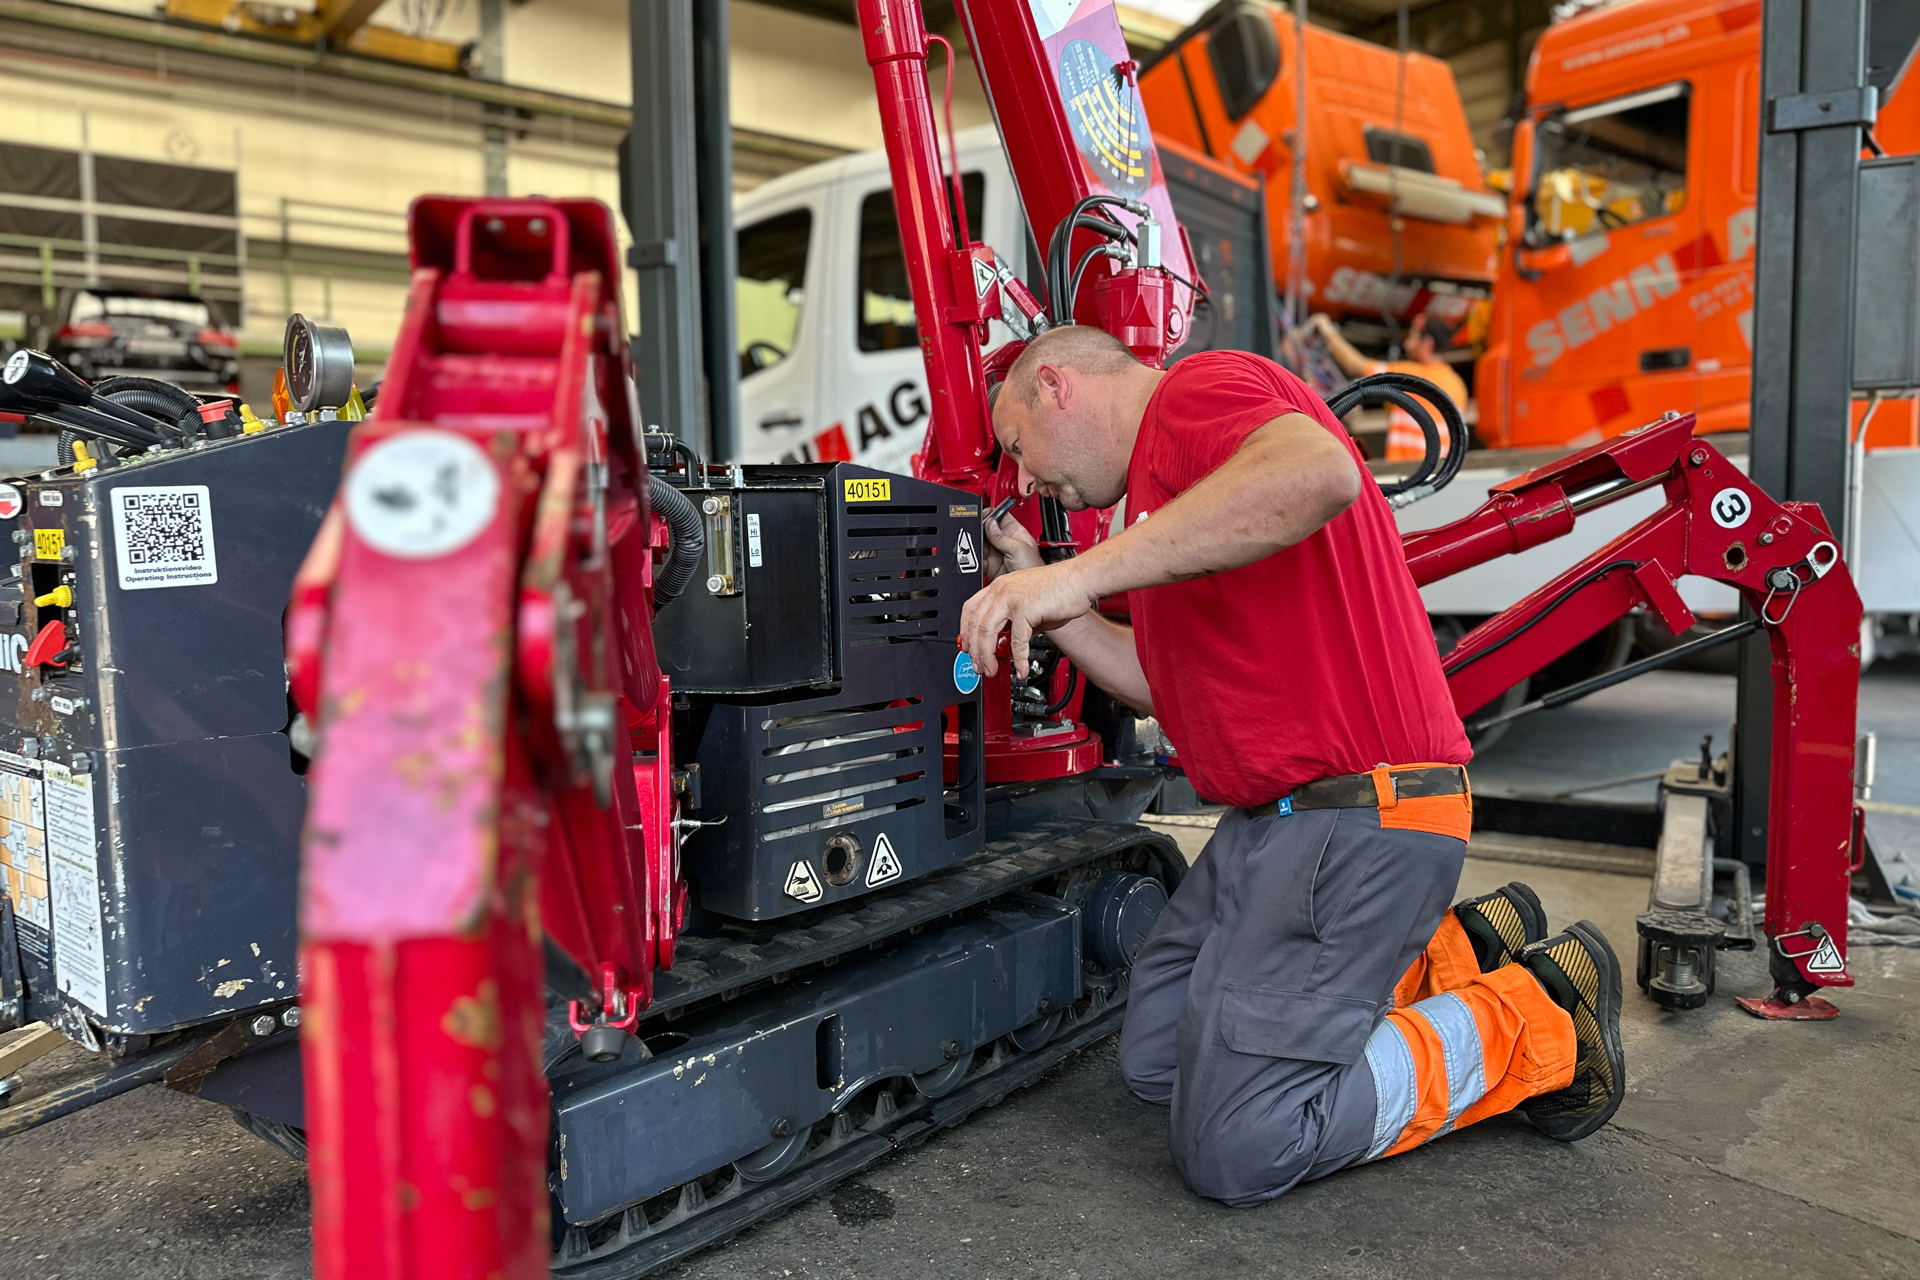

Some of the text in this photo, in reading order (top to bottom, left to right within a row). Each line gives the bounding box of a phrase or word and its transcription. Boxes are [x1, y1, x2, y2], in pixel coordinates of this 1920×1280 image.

[1525, 252, 1681, 368] SENN
[857, 380, 929, 452] AG
[847, 482, 888, 499] 40151
[1716, 493, 1747, 524] 3
[125, 572, 212, 583] Operating Instructions
[134, 565, 202, 574] Instruktionsvideo
